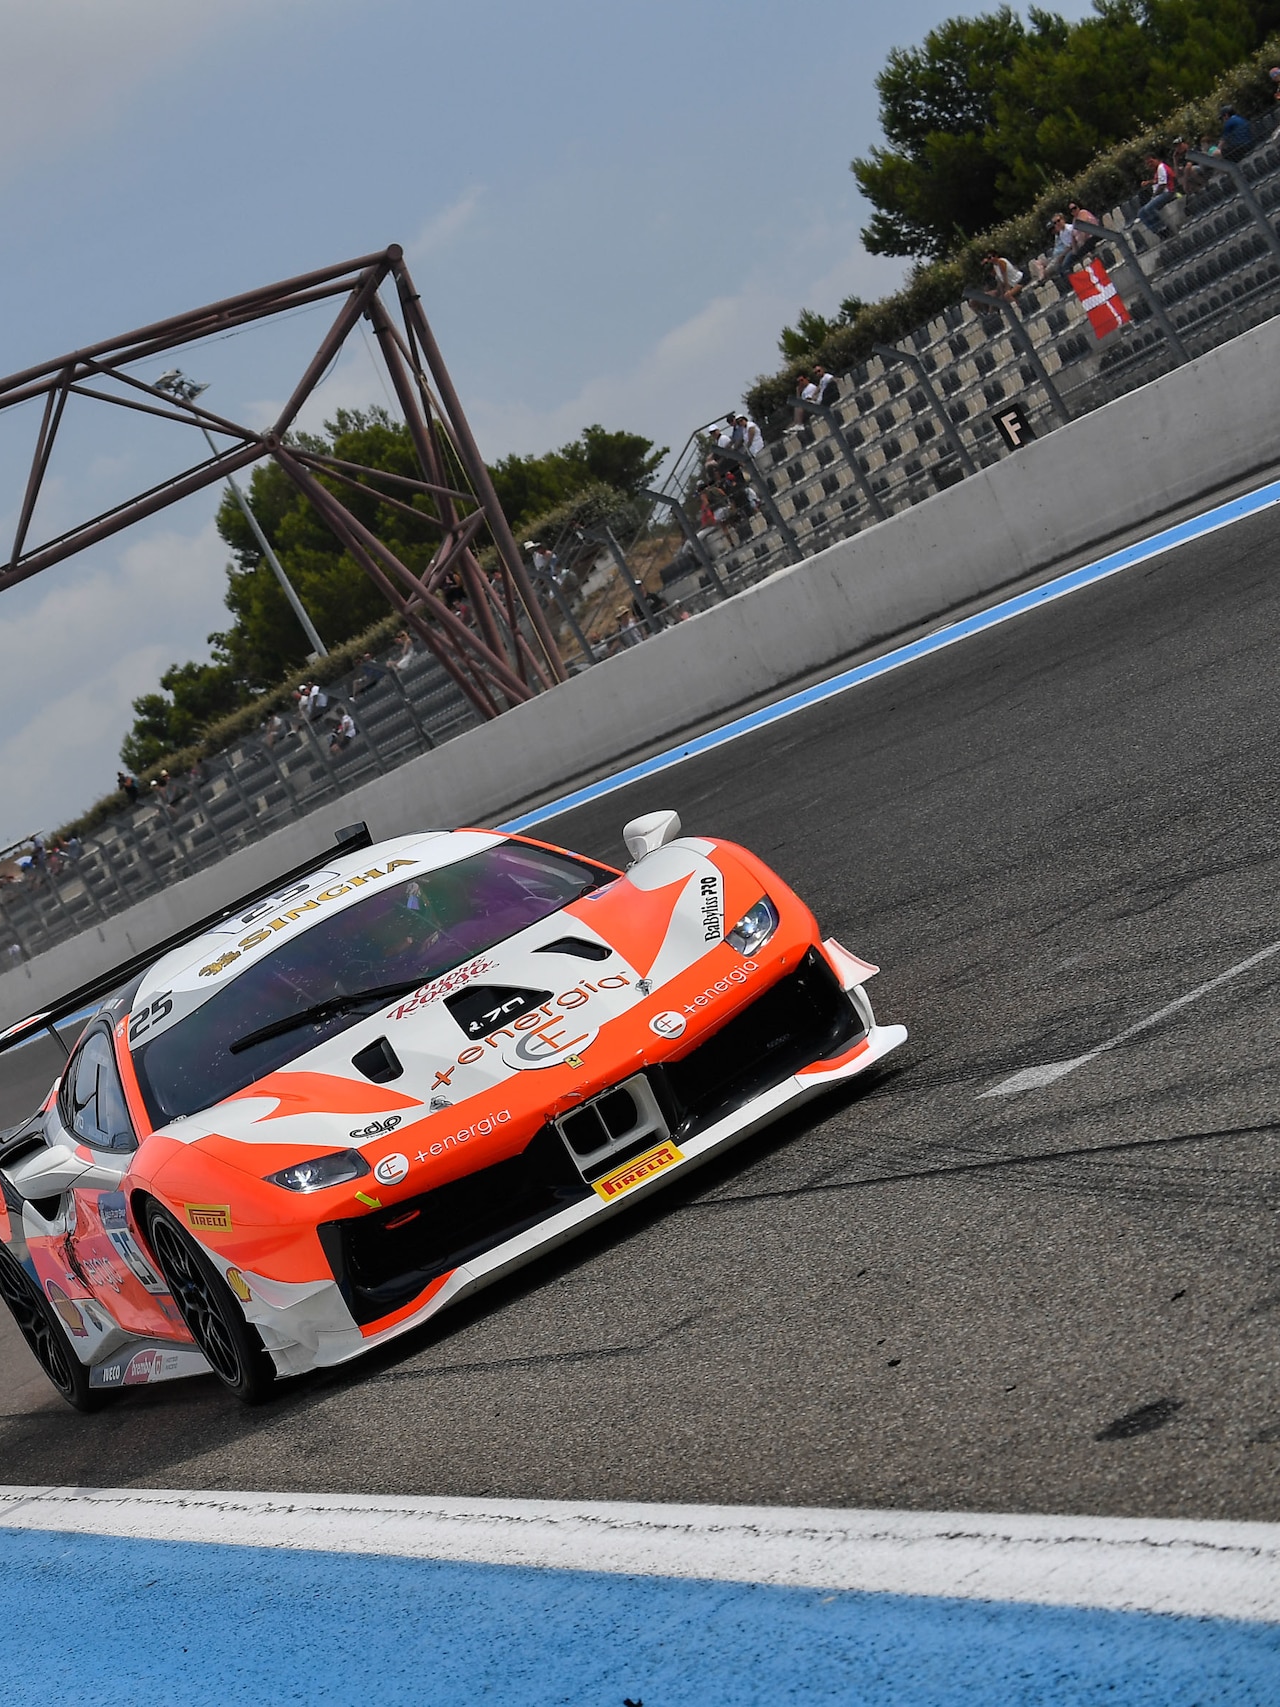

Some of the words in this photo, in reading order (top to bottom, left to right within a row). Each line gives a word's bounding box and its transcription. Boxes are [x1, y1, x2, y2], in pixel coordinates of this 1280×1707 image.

[1001, 411, 1022, 446] F
[238, 859, 421, 952] SINGHA
[386, 960, 493, 1020] Rosso
[414, 956, 487, 998] Cuore
[129, 989, 173, 1043] 25
[601, 1148, 674, 1195] PIRELLI
[189, 1209, 227, 1227] PIRELLI
[103, 1365, 120, 1382] IVECO
